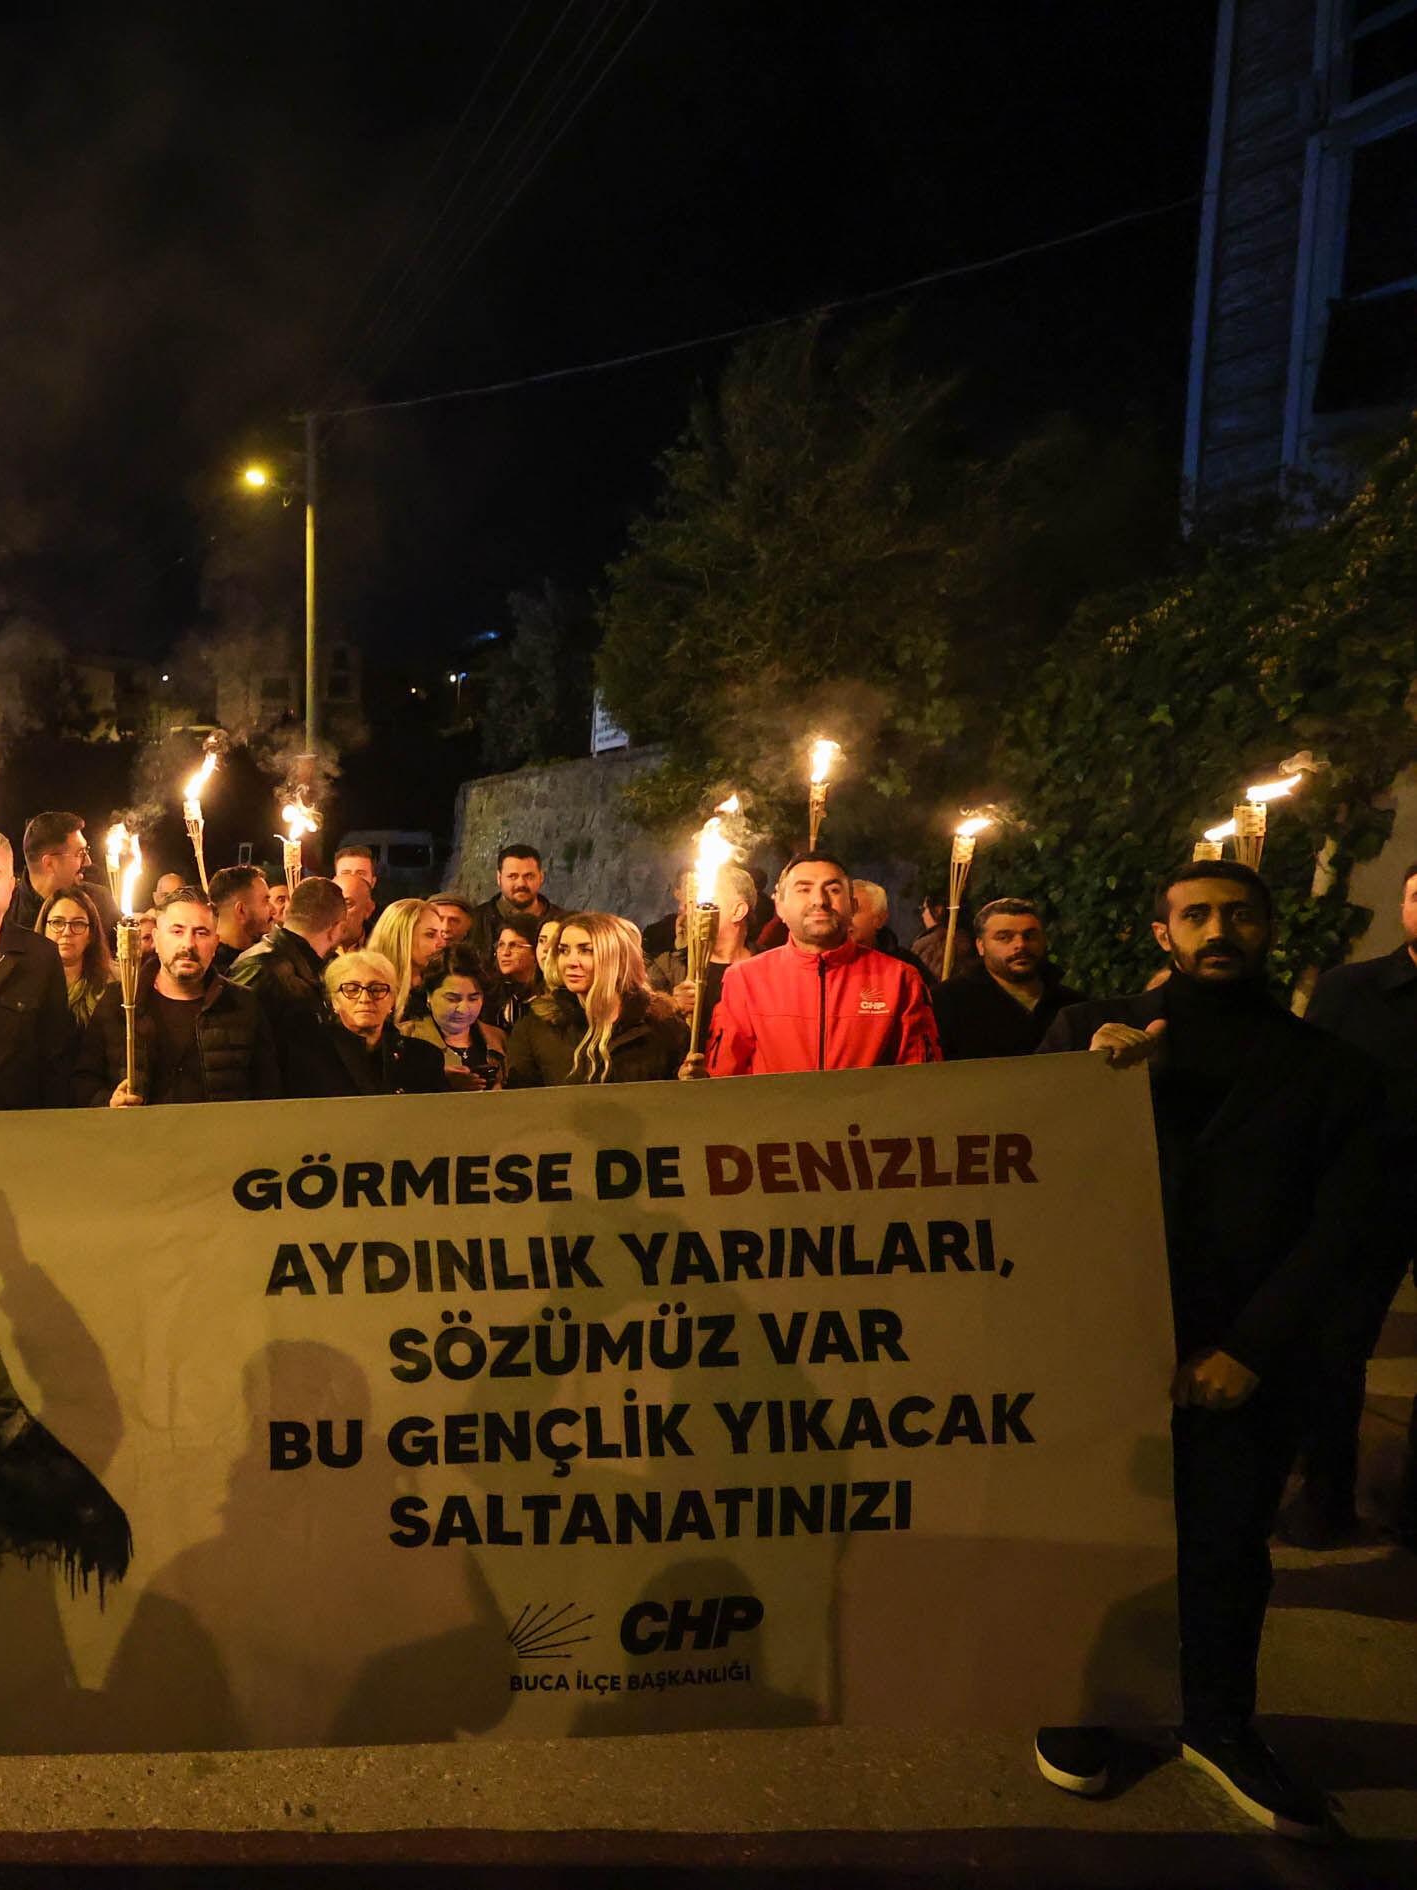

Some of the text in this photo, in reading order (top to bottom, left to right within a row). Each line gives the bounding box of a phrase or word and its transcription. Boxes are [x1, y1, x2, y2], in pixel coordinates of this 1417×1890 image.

[232, 1124, 1038, 1211] GÖRMESE DE DENİZLER
[266, 1219, 1014, 1296] AYDINLIK YARINLARI,
[389, 1302, 910, 1383] SÖZÜMÜZ VAR
[268, 1388, 1036, 1478] BU GENÇLİK YIKACAK
[389, 1480, 911, 1548] SALTANATINIZI
[620, 1595, 764, 1656] CHP
[510, 1661, 751, 1695] BUCA İLÇE BAŞKANLIĞI
